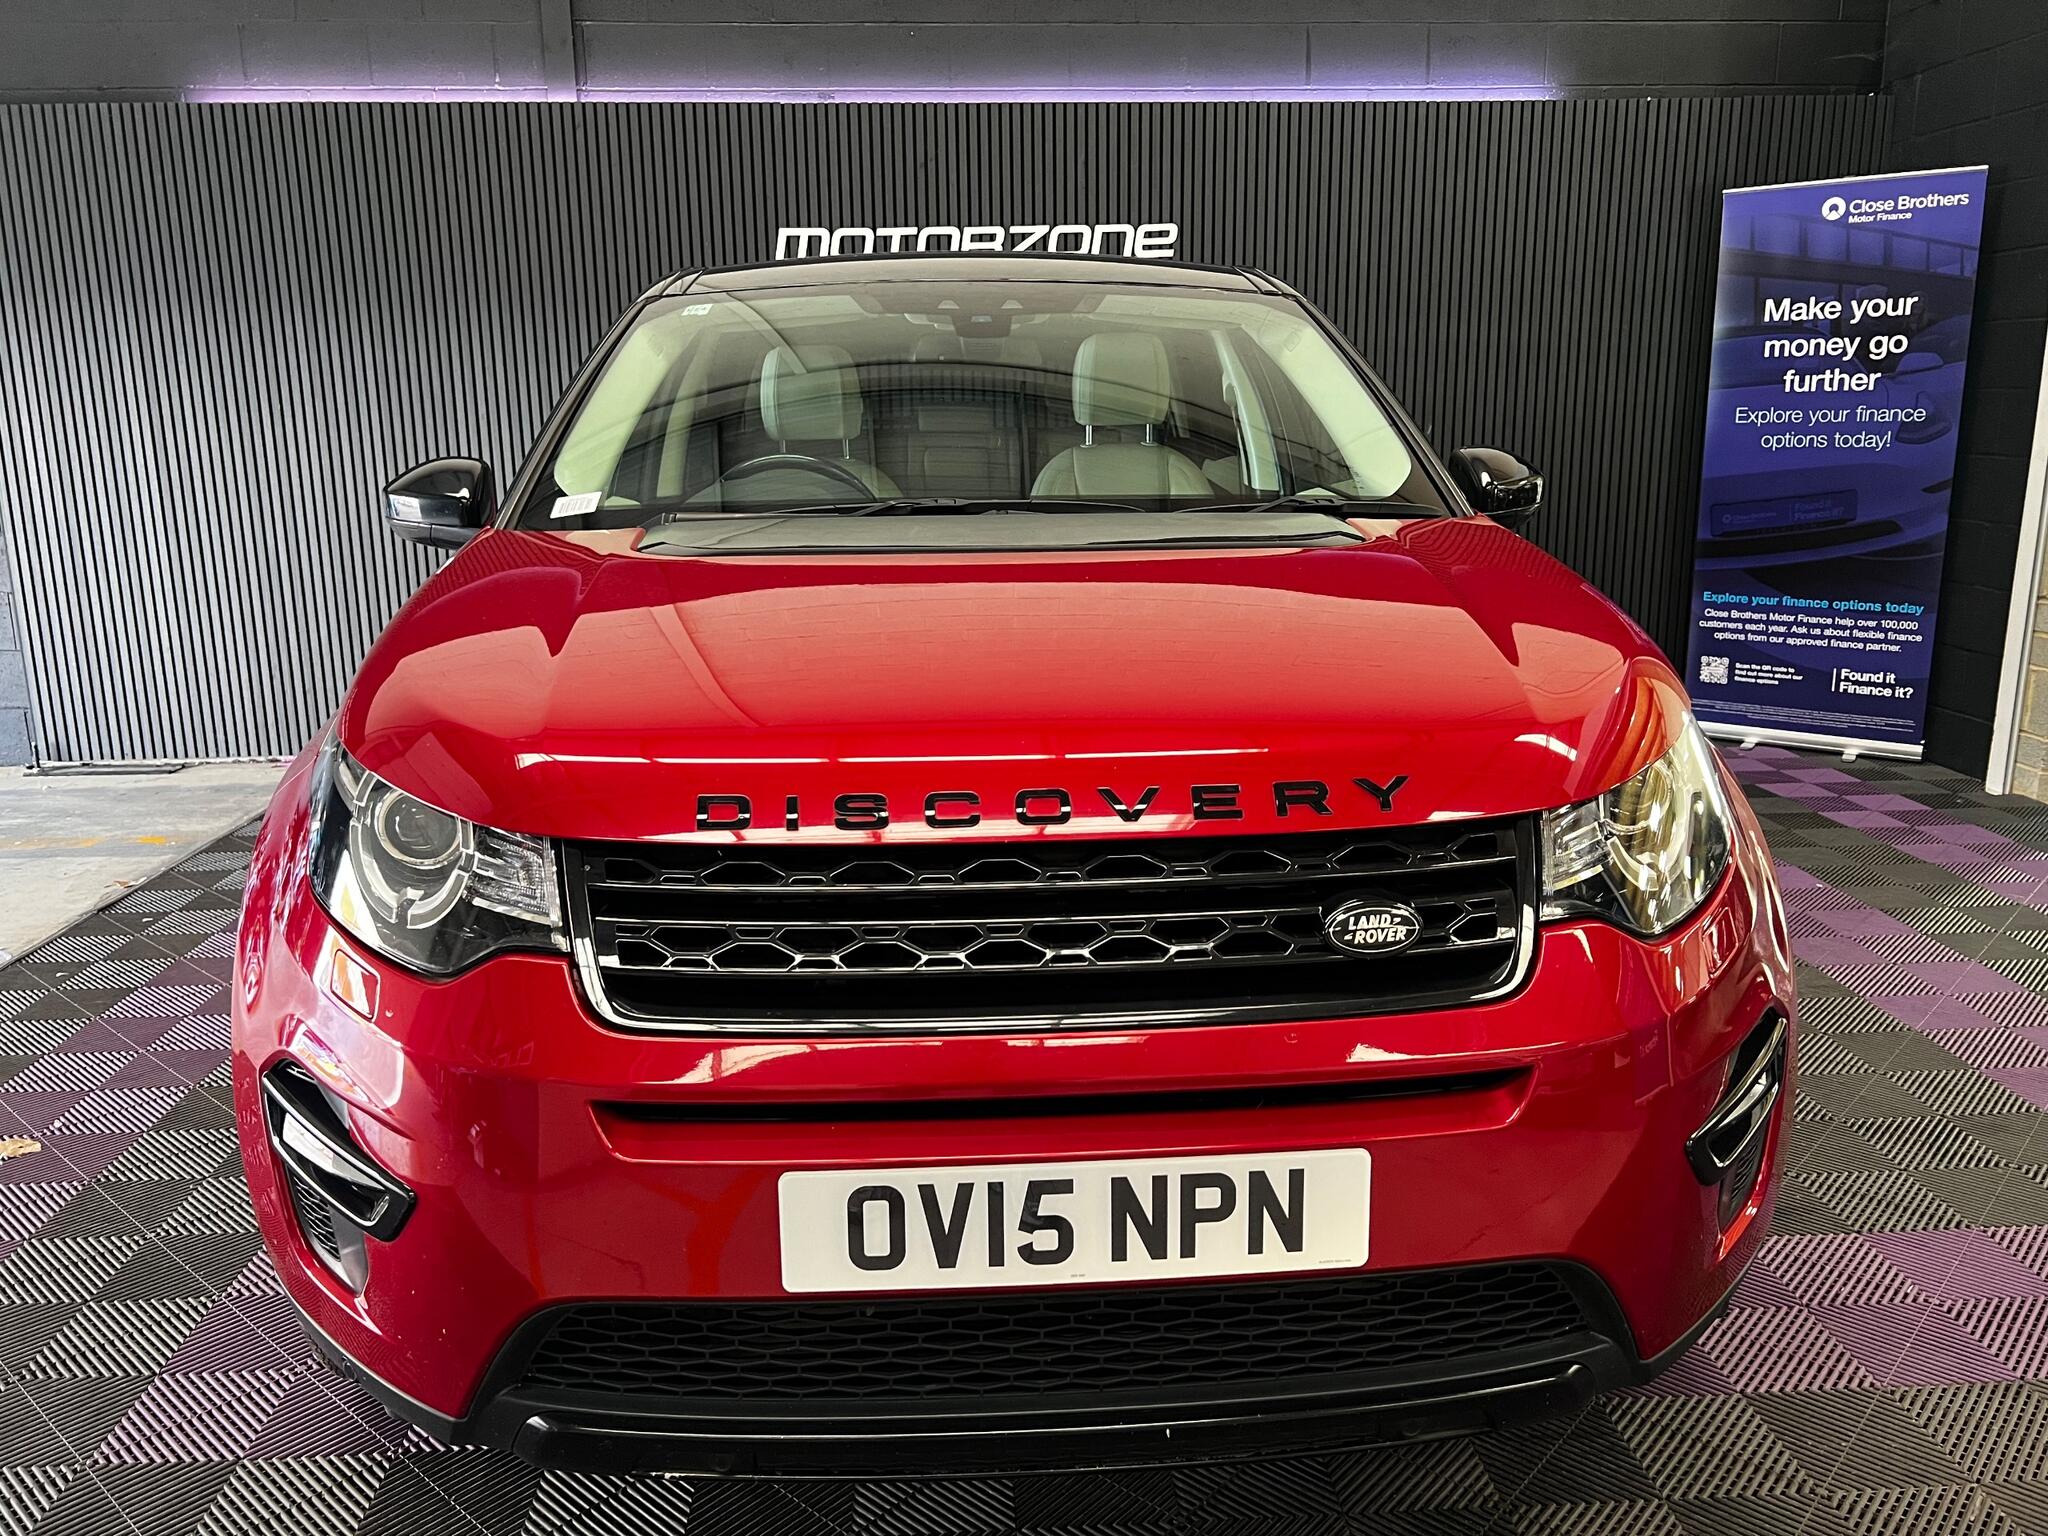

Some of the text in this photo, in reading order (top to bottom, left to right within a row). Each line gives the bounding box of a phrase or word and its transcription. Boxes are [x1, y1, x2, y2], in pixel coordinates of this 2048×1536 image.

[1849, 193, 1970, 214] Close Brothers
[1848, 212, 1912, 224] Motor Finance
[1763, 296, 1919, 325] Make your
[1763, 334, 1909, 361] money go
[1783, 368, 1882, 393] further
[1735, 405, 1926, 427] Explore your finance
[1760, 430, 1891, 451] options today!
[1703, 591, 1924, 616] Explore your finance options today
[1699, 619, 1923, 643] customers each year. Ask us about flexible finance
[1704, 608, 1919, 631] Close Brothers Motor Finance help over 100,000
[1713, 631, 1902, 653] options from our approved finance partner.
[1840, 668, 1896, 685] Found it
[1839, 681, 1914, 699] Finance it?
[695, 775, 1409, 832] DISCOVERY
[846, 1167, 1305, 1272] OV15 NPN
